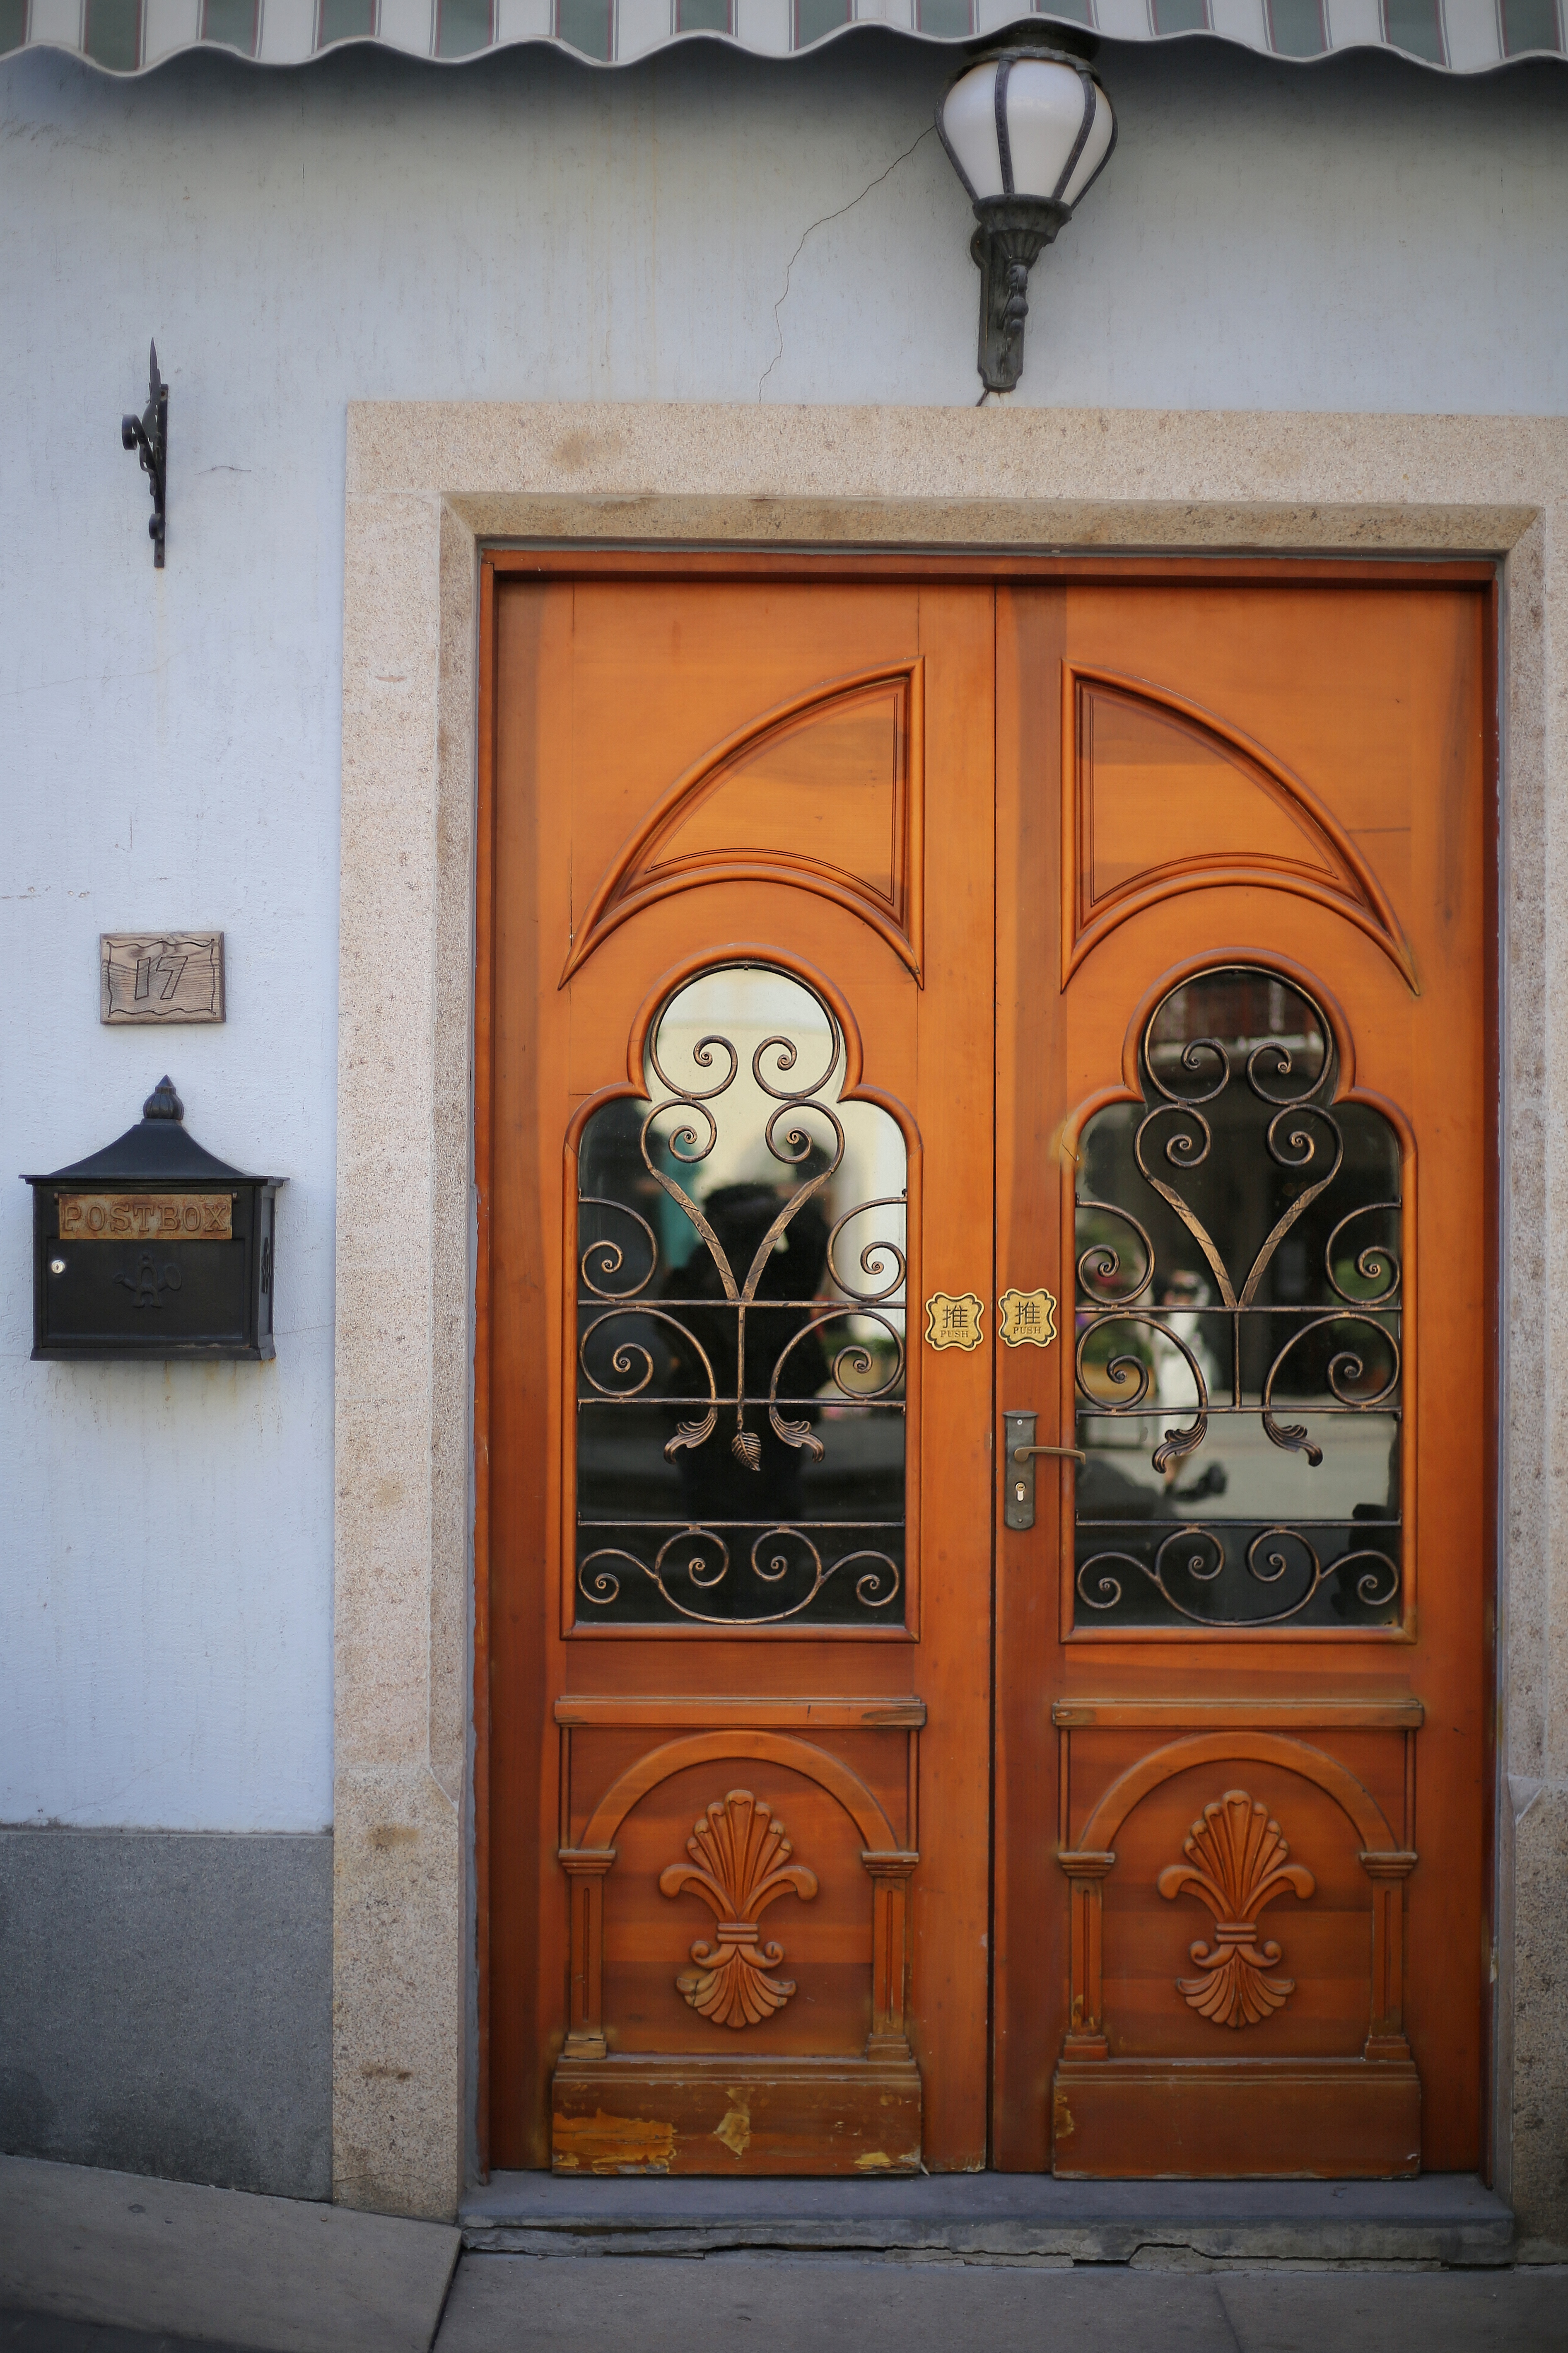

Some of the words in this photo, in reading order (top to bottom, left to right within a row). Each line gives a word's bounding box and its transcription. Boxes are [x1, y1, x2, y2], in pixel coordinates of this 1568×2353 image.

[134, 955, 188, 1000] 17
[63, 1204, 227, 1232] POSTBOX
[942, 1305, 968, 1328] 推
[1015, 1302, 1040, 1324] 推
